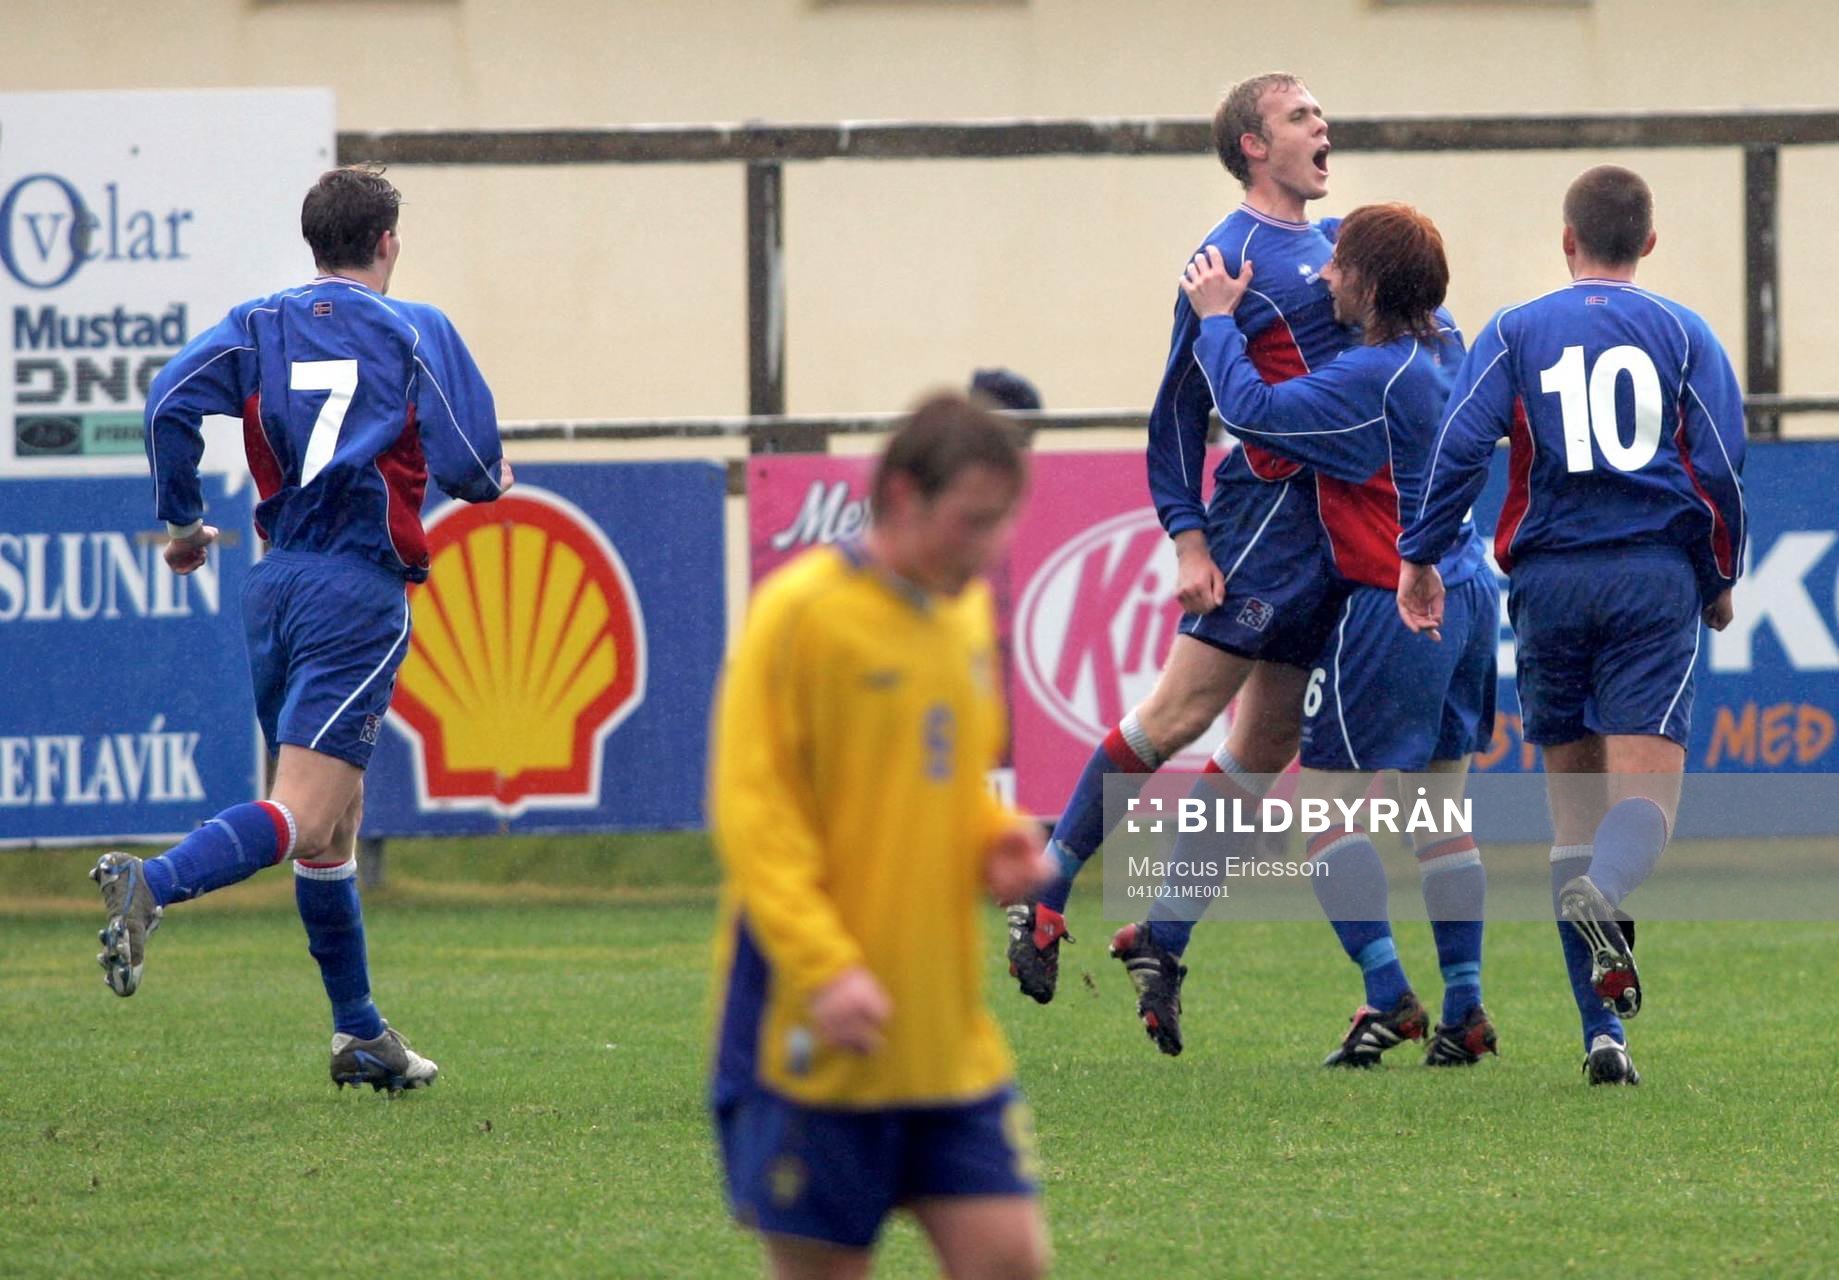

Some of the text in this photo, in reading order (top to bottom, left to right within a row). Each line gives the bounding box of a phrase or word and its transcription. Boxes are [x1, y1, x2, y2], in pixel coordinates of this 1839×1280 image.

[13, 303, 188, 348] Mustad
[290, 359, 358, 488] 7
[1540, 345, 1663, 472] 10
[1303, 667, 1326, 717] 6
[0, 714, 205, 804] EFLAVÍK
